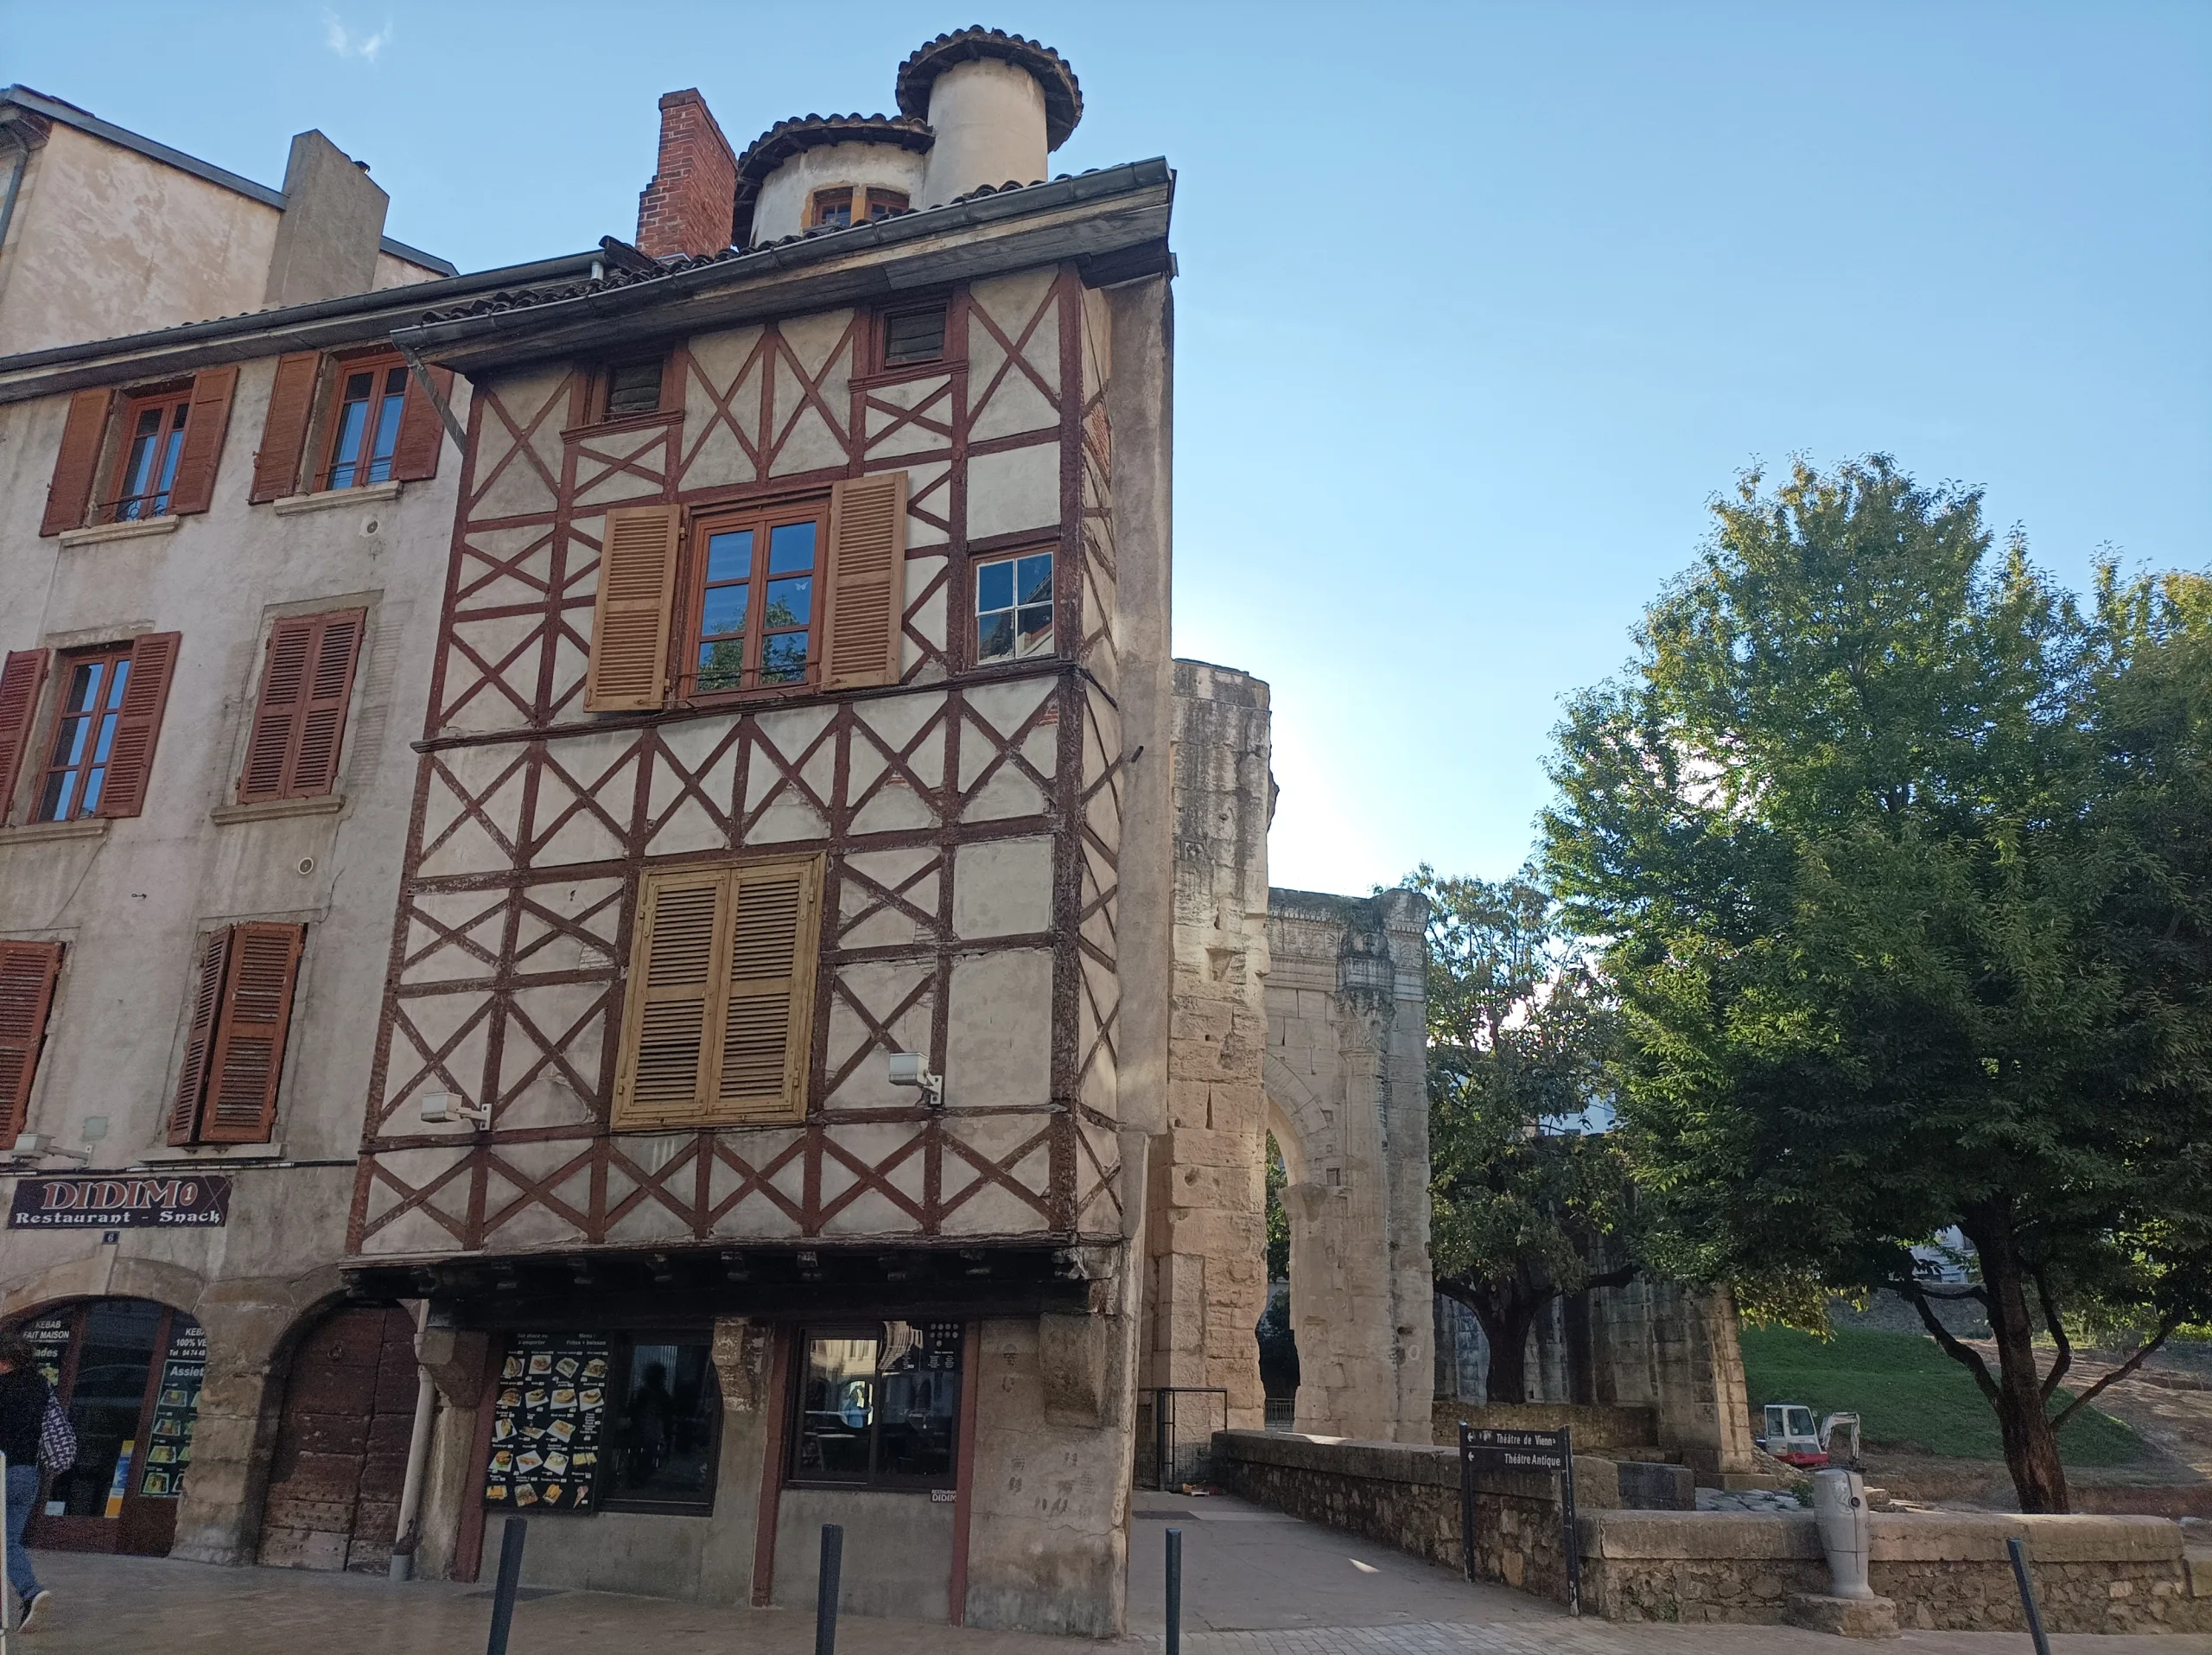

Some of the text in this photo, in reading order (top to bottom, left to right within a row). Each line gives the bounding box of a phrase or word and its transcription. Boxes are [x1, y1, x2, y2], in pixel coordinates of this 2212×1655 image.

[16, 1211, 131, 1225] Restaurant
[159, 1210, 220, 1224] Snack
[107, 1232, 115, 1243] 6
[35, 1320, 61, 1329] KEBAB
[40, 1329, 70, 1340] MAISON
[185, 1327, 205, 1336] KEB
[176, 1338, 195, 1346] 100%
[34, 1347, 58, 1358] ades
[1523, 1434, 1532, 1445] de
[1504, 1453, 1560, 1468] Théâtre Antique
